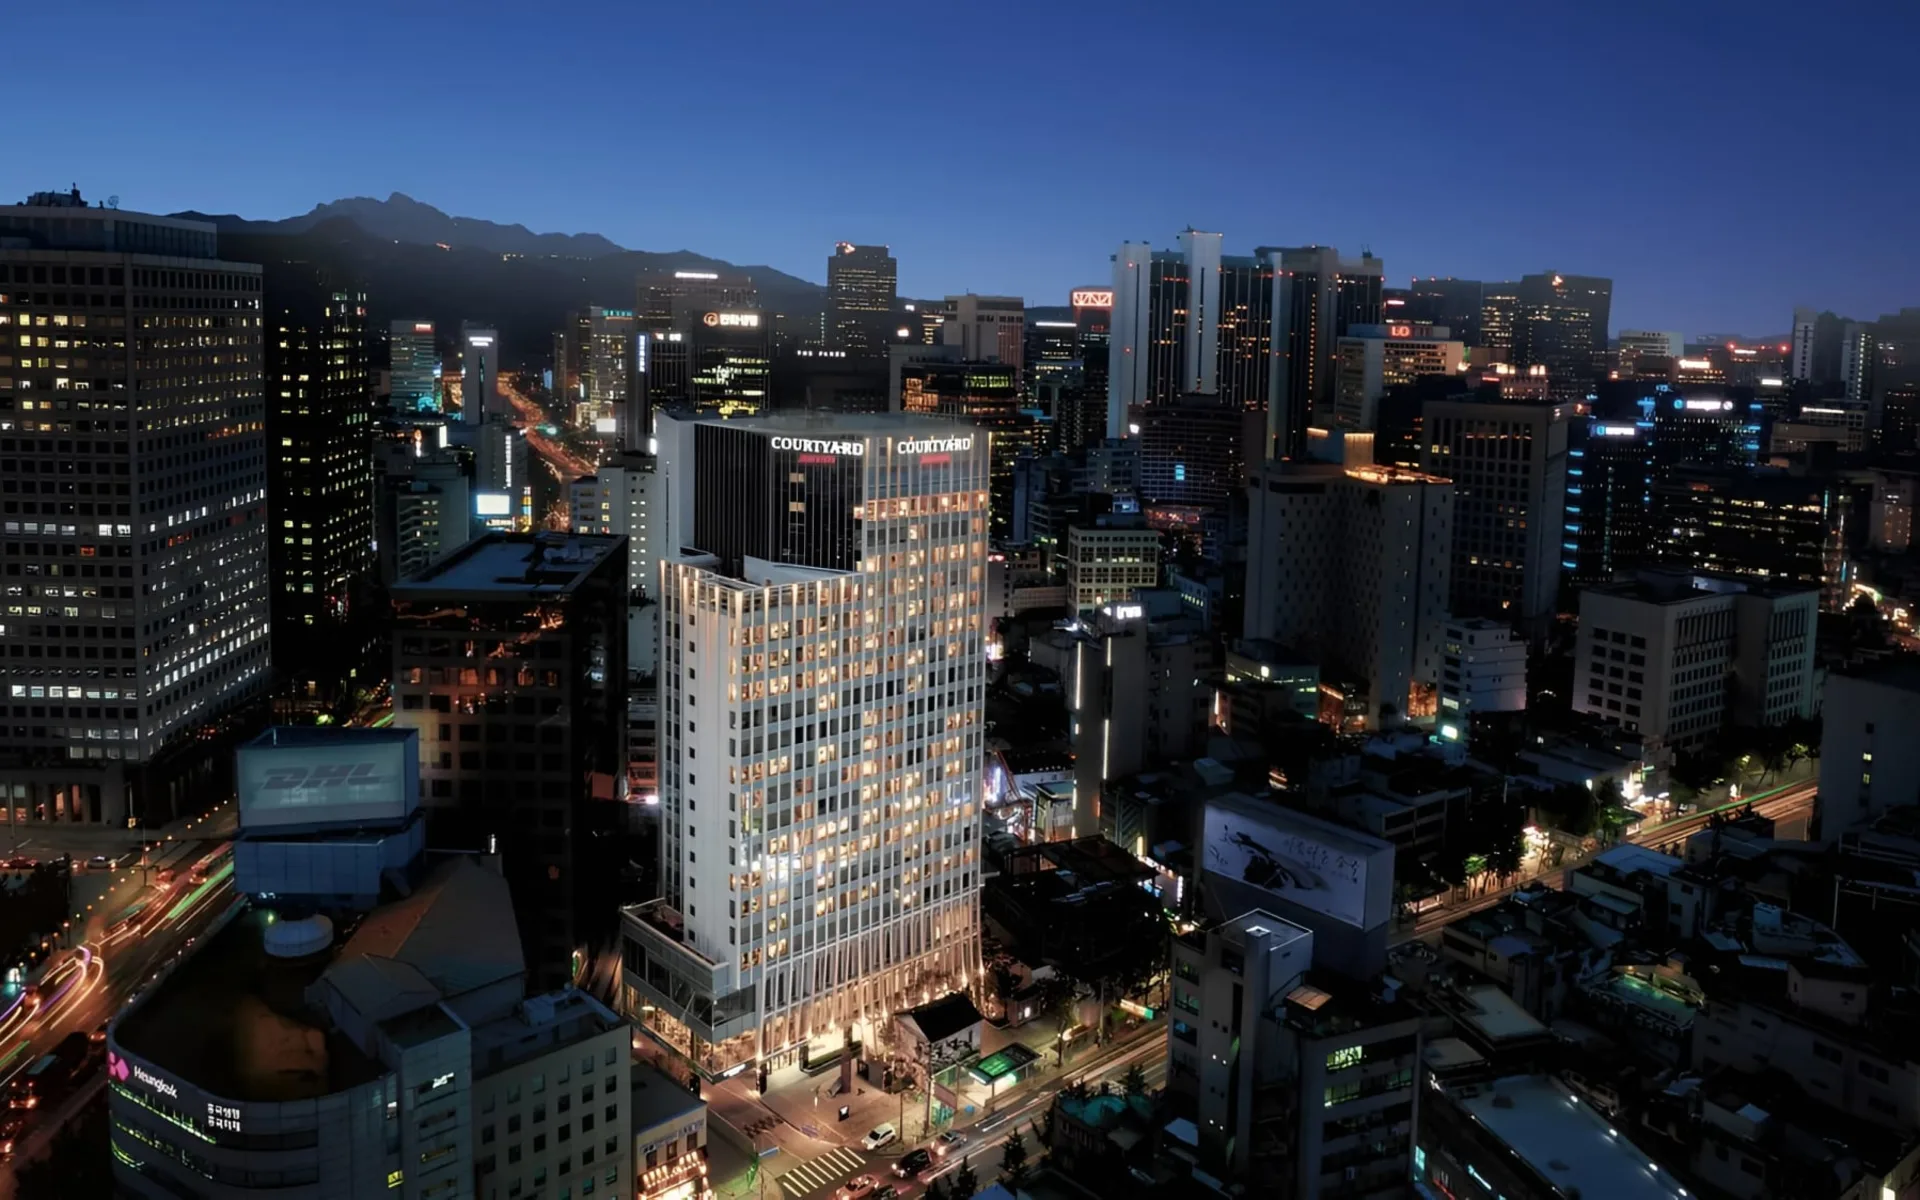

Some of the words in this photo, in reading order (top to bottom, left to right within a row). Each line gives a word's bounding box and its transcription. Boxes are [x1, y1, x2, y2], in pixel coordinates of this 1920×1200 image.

[771, 436, 864, 456] COURTYARD
[897, 437, 971, 455] COURTYARD
[262, 763, 381, 790] DHL
